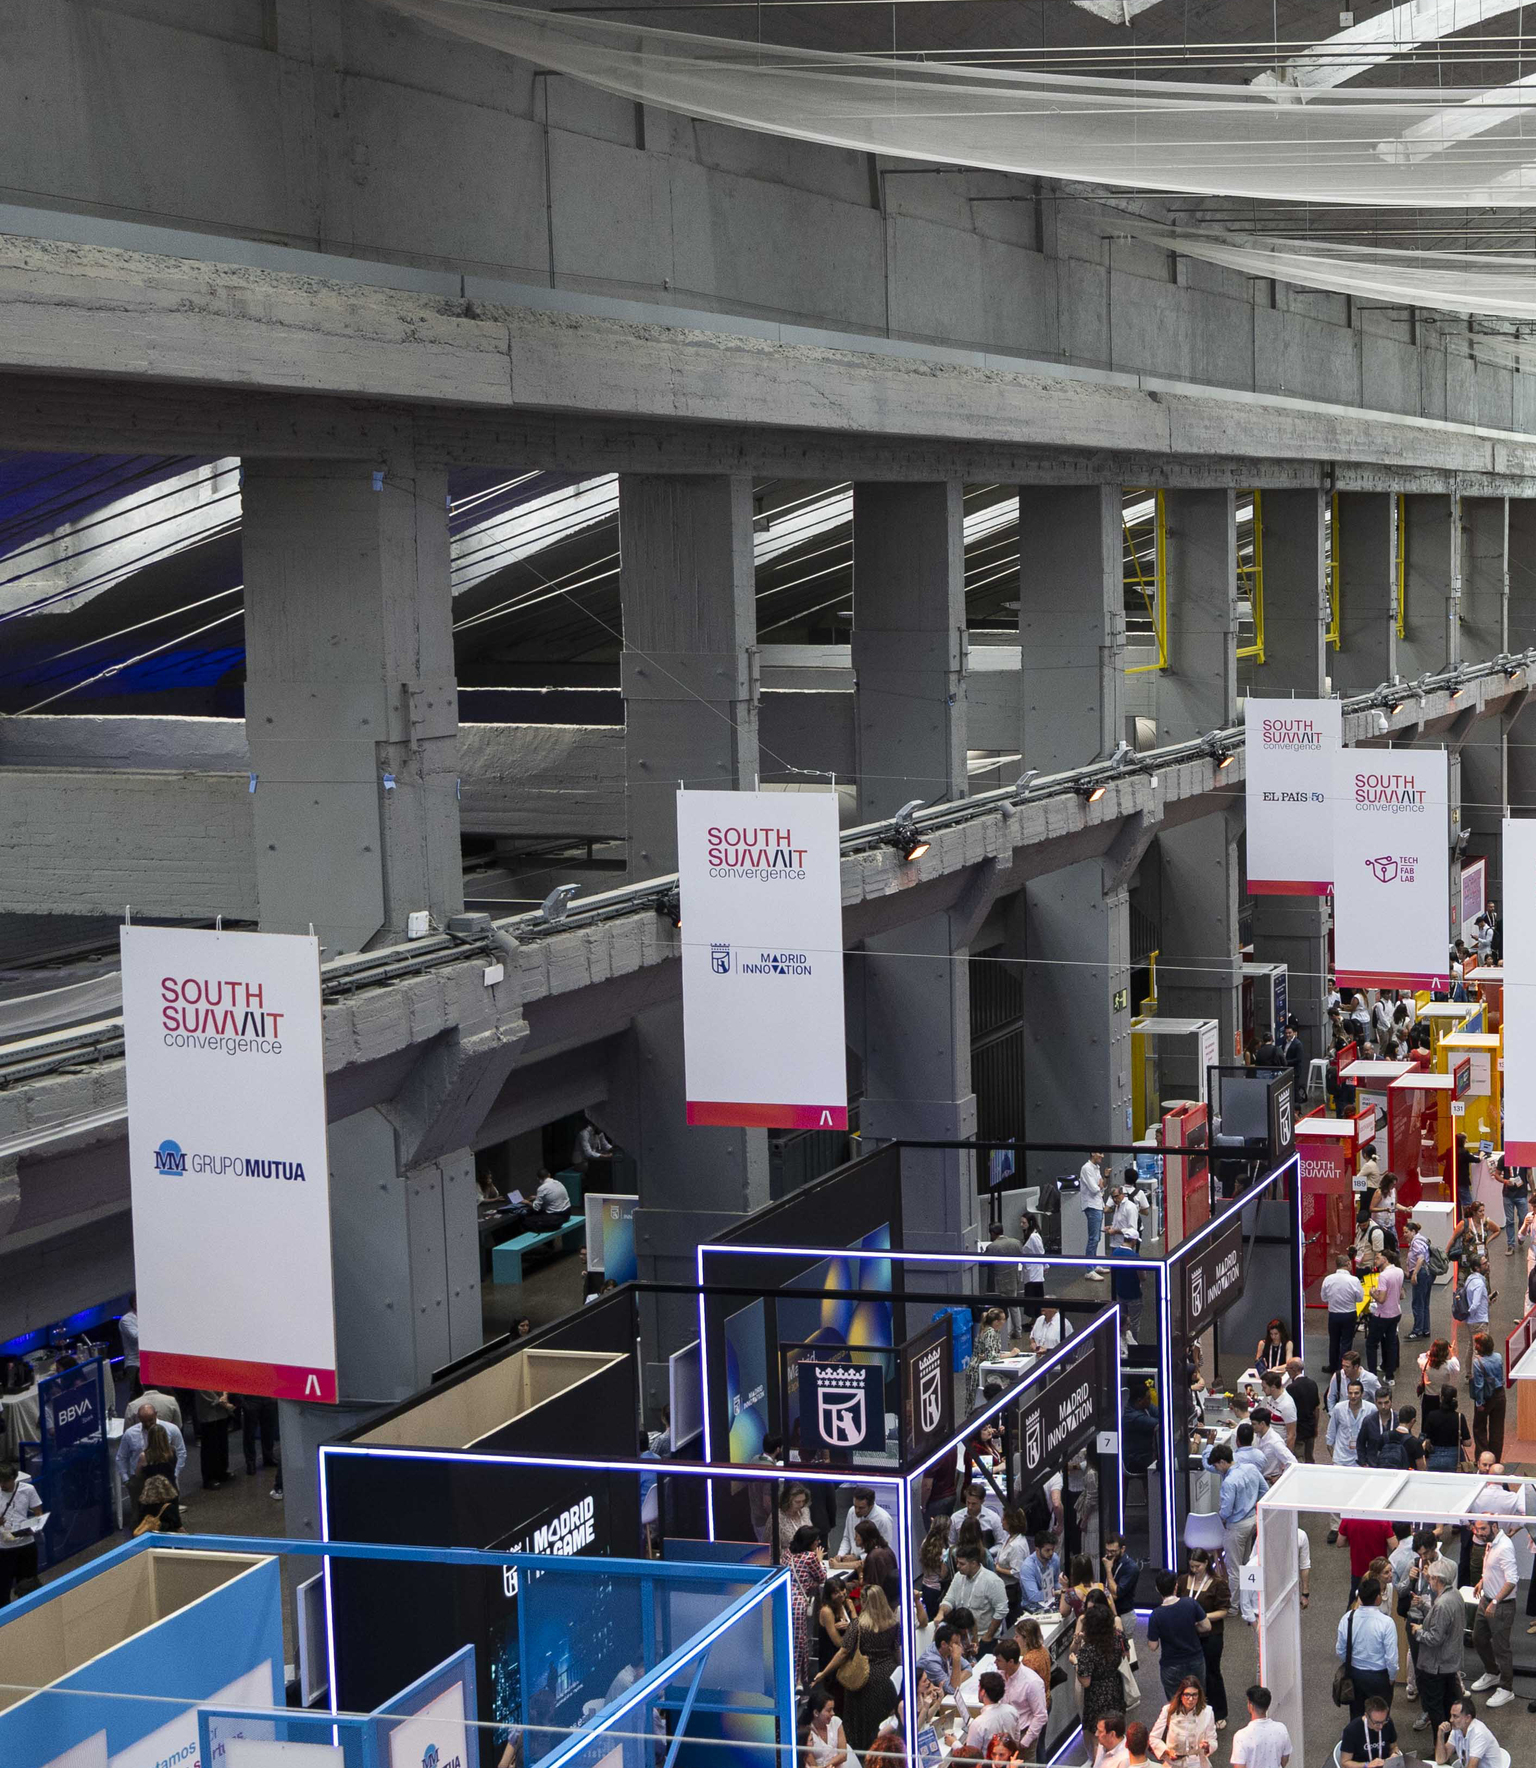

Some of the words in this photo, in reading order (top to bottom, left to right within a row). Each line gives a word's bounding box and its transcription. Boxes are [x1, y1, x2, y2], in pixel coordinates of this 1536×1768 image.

[1263, 720, 1313, 731] SOUTH
[1263, 732, 1322, 743] SUMMIT
[1264, 743, 1322, 752] convergence
[1355, 774, 1414, 789] SOUTH
[1263, 792, 1279, 801] EL
[1355, 789, 1426, 804] SUMMIT
[1356, 803, 1424, 814] convergence
[708, 827, 791, 848] SOUTH
[708, 848, 808, 868] SUMMIT
[1400, 856, 1418, 864] TECH
[709, 868, 806, 882] convergence
[760, 952, 807, 964] MADRID
[742, 964, 812, 976] INNOVATION
[161, 977, 263, 1008] SOUTH
[162, 1006, 284, 1038] SUMMIT
[164, 1032, 282, 1056] convergence
[1300, 1161, 1334, 1170] SOUTH
[1300, 1170, 1341, 1179] SUMMIT
[1215, 1250, 1237, 1278] MADRID
[1207, 1268, 1240, 1304] INNOVATION
[1059, 1382, 1089, 1420] MADRID
[58, 1398, 92, 1426] BBVA
[1048, 1397, 1092, 1452] INNOVATION
[1104, 1438, 1111, 1447] 7
[533, 1496, 594, 1552] MADRID
